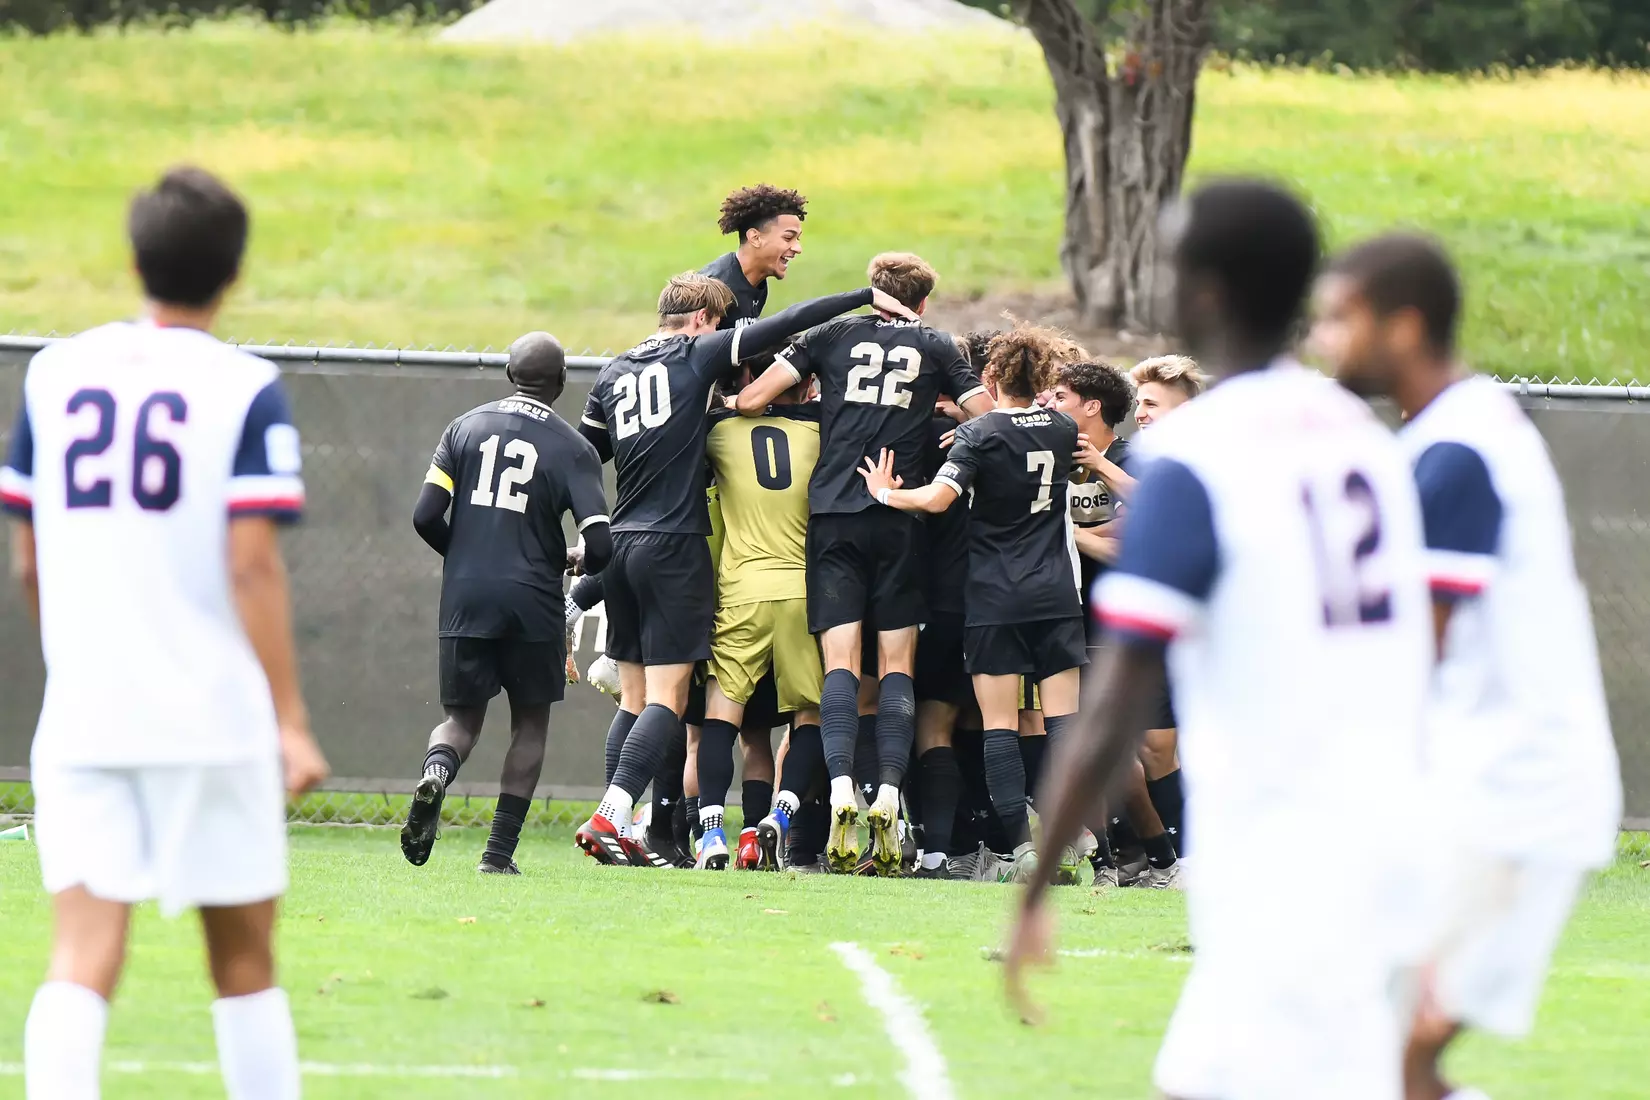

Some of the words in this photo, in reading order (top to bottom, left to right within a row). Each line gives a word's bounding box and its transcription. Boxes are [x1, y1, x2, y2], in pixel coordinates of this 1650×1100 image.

[612, 361, 672, 440] 20
[844, 341, 922, 409] 22
[65, 387, 187, 512] 26
[470, 434, 539, 514] 12
[751, 425, 792, 490] 0
[1026, 450, 1056, 514] 7
[1071, 493, 1110, 509] DONS
[1301, 469, 1393, 627] 12
